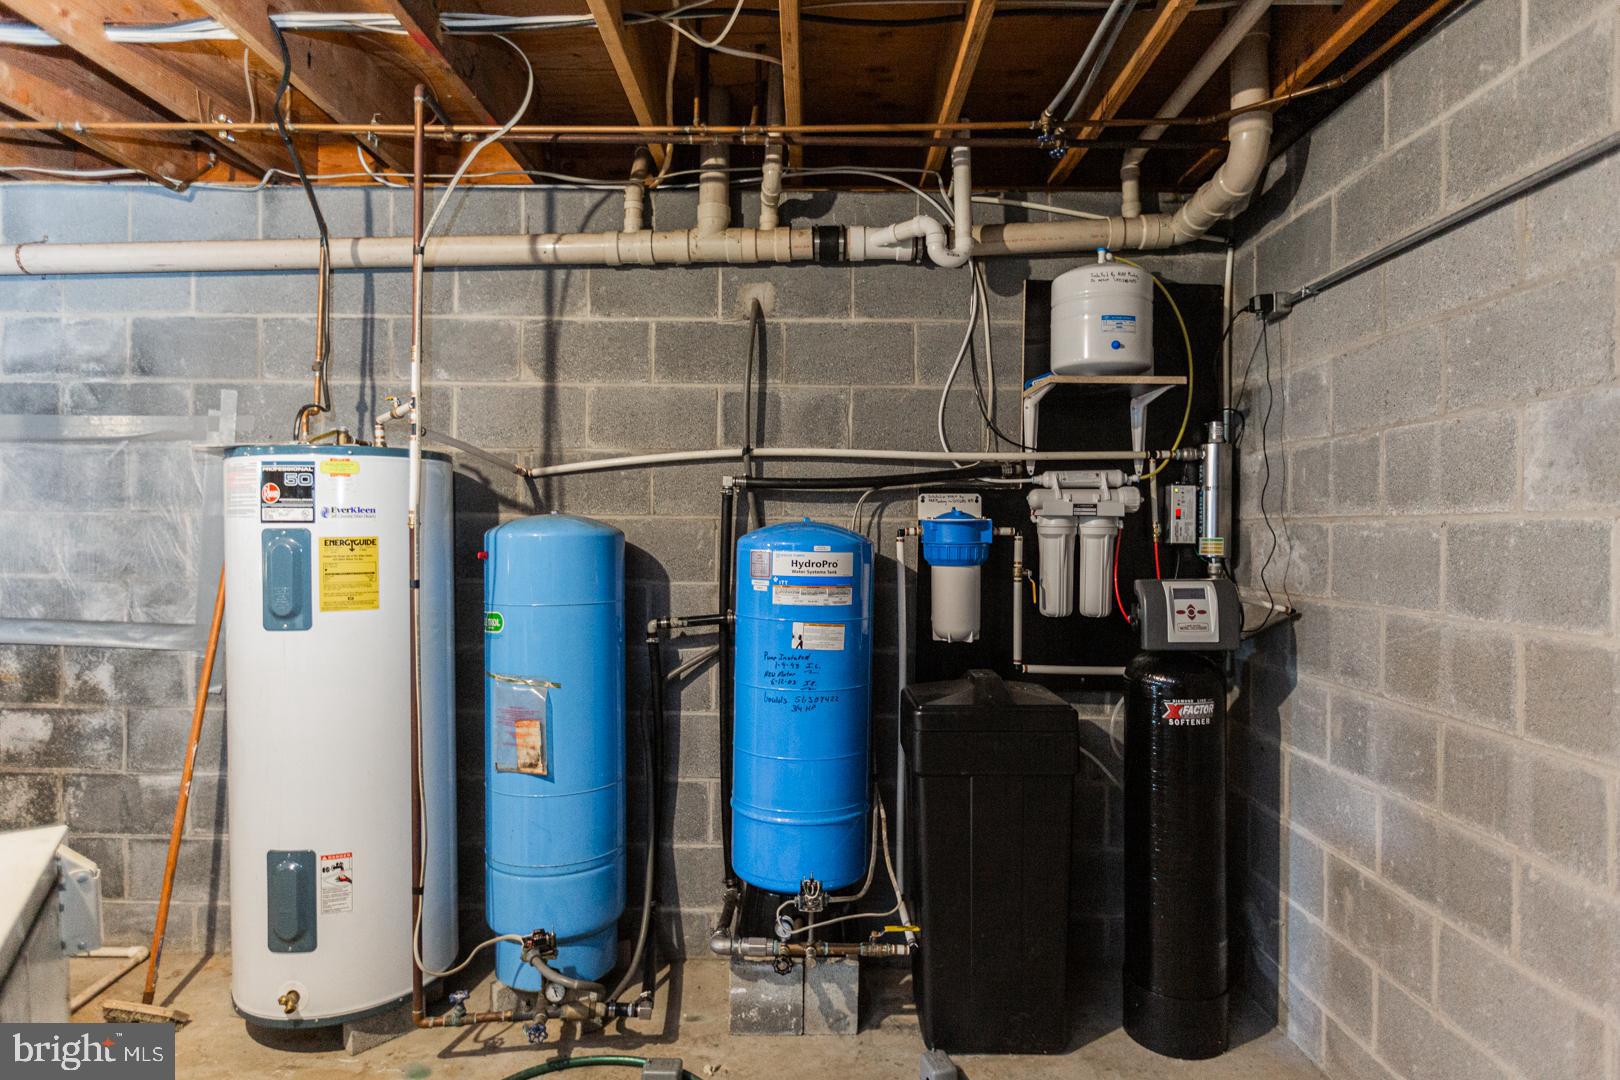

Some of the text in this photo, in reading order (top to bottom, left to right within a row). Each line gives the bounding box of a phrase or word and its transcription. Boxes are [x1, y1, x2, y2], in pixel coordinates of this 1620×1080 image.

[284, 472, 313, 486] 50
[791, 559, 838, 569] HydroPro
[1168, 718, 1211, 726] SOFTENER
